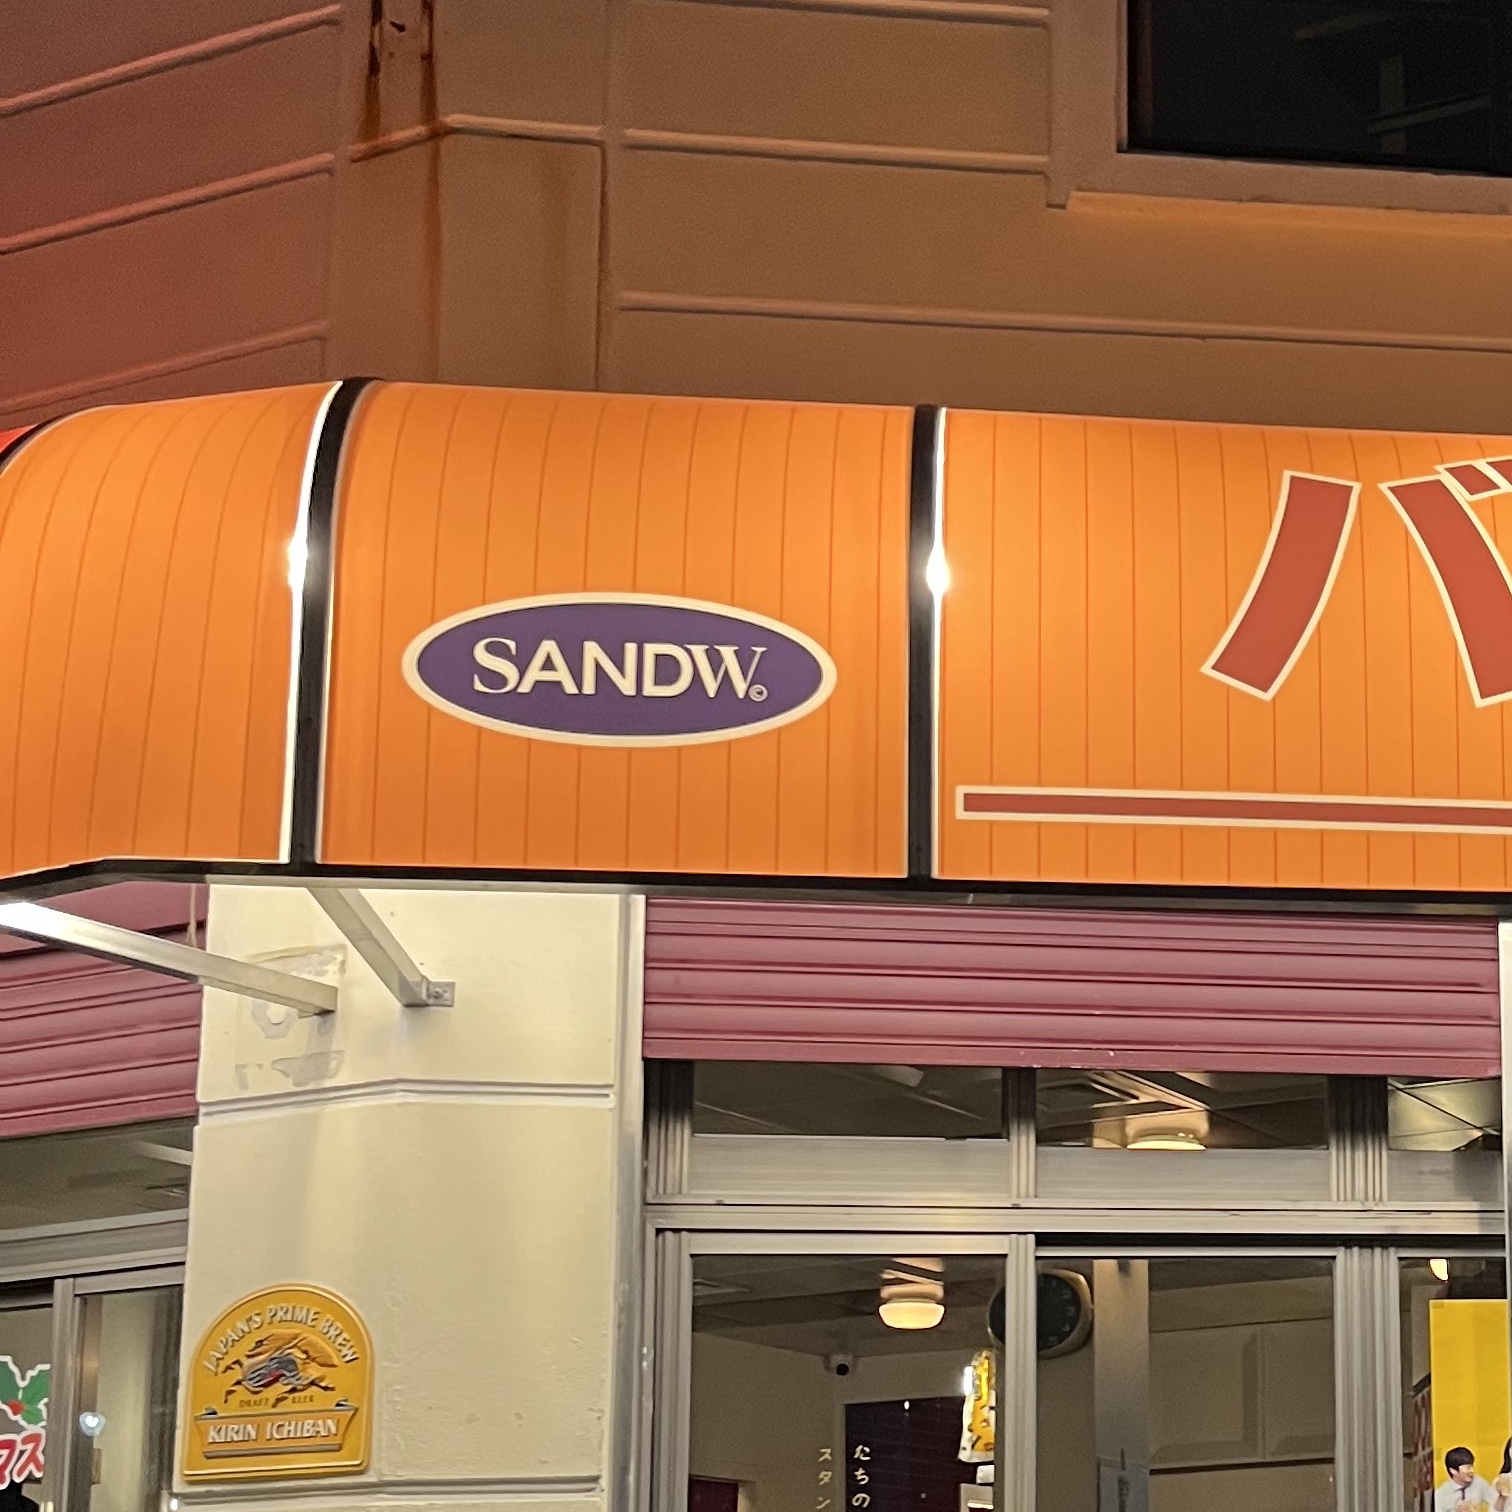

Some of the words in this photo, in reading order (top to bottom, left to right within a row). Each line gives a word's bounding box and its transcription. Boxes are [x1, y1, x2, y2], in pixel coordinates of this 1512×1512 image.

[203, 1311, 264, 1376] JAPAN'S
[267, 1304, 321, 1327] PRIME
[321, 1315, 359, 1363] BREW
[207, 1423, 258, 1444] KIRIN
[266, 1418, 339, 1440] ICHIBAN
